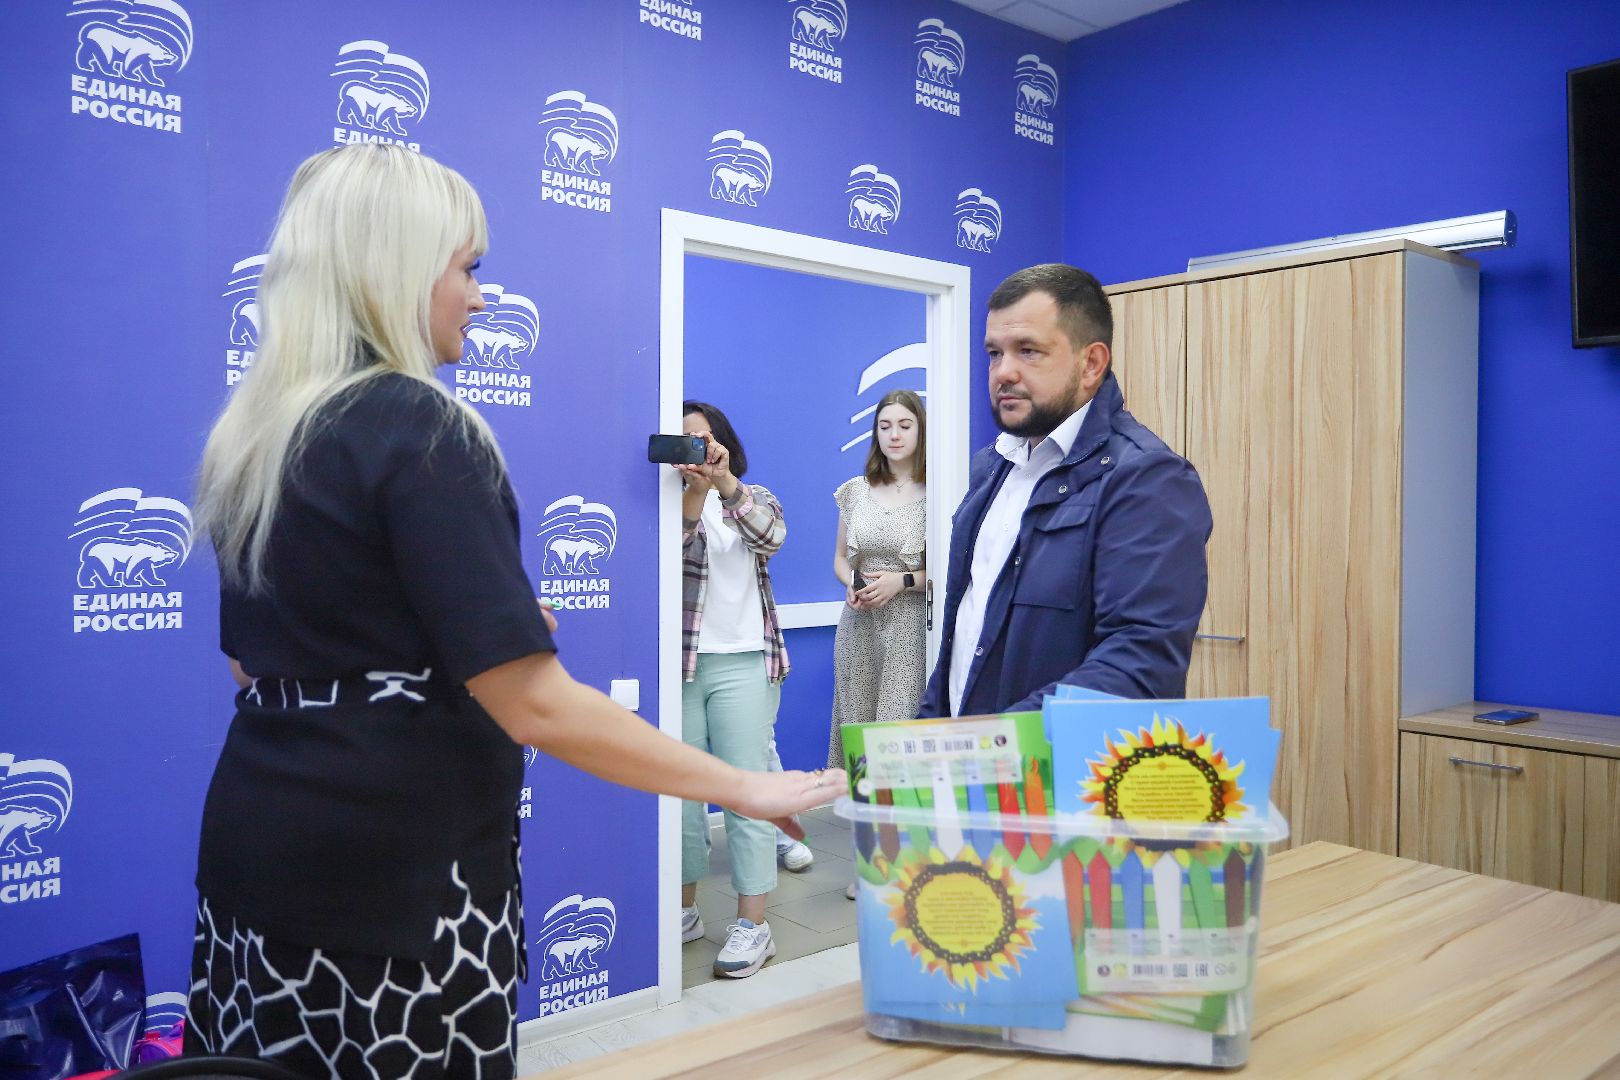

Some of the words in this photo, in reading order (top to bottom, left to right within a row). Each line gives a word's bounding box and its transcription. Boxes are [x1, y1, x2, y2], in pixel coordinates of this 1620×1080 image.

[640, 9, 701, 40] РОССИЯ
[790, 42, 841, 68] ЕДИНАЯ
[790, 56, 841, 83] РОССИЯ
[72, 74, 181, 112] ЕДИНАЯ
[916, 80, 960, 103] ЕДИНАЯ
[72, 96, 181, 133] РОССИЯ
[916, 93, 960, 116] РОССИЯ
[1015, 111, 1053, 132] ЕДИНАЯ
[1015, 124, 1053, 145] РОССИЯ
[542, 170, 611, 195] ЕДИНАЯ
[542, 186, 611, 212] РОССИЯ
[456, 369, 530, 388] ЕДИНАЯ
[456, 387, 530, 406] РОССИЯ
[541, 579, 609, 595] ЕДИНАЯ
[74, 592, 182, 612] ЕДИНАЯ
[74, 612, 182, 632] РОССИЯ
[1, 857, 60, 881] НАЯ
[0, 878, 61, 903] СИЯ
[540, 970, 608, 1000] ЕДИНАЯ
[540, 986, 608, 1017] РОССИЯ
